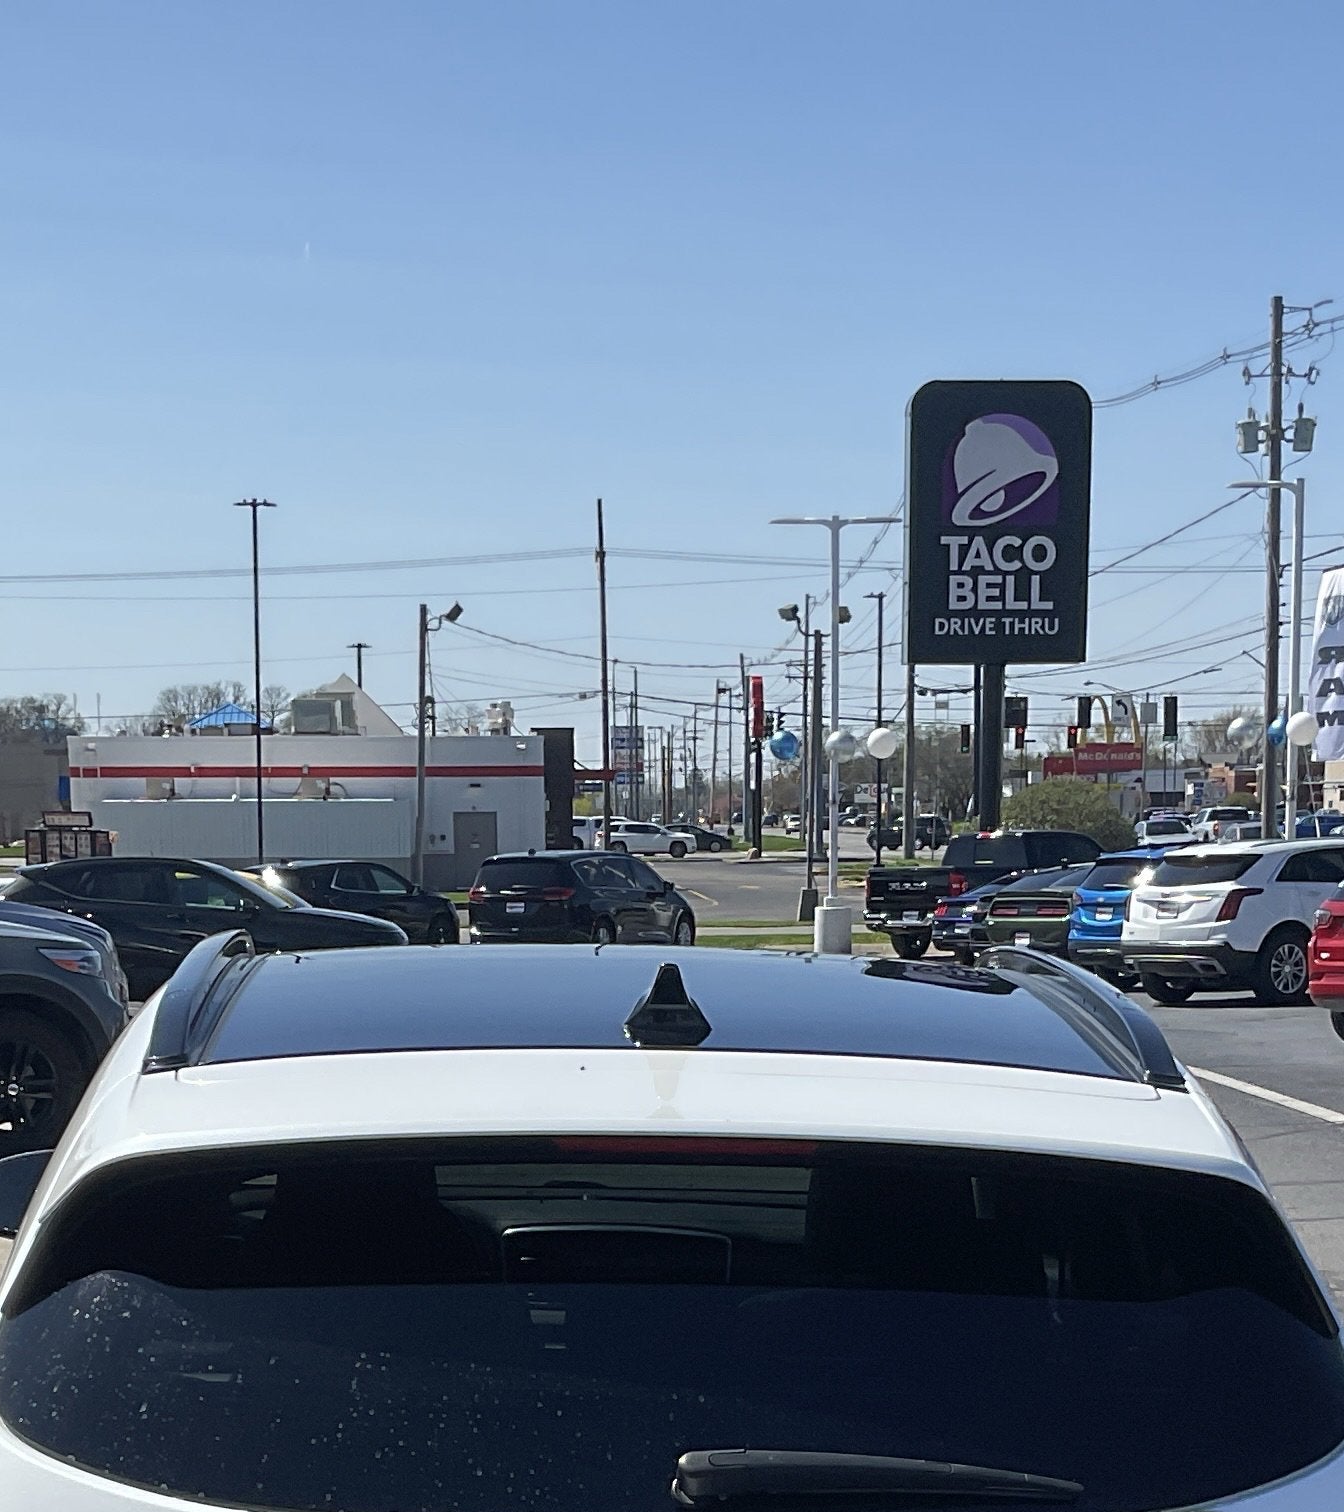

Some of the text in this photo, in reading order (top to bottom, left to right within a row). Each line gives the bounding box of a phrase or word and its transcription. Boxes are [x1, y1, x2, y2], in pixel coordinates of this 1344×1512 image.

[940, 535, 1057, 571] TACO
[948, 574, 1054, 610] BELL
[934, 617, 1060, 635] DRIVE THRU
[1077, 751, 1142, 761] McDonald's
